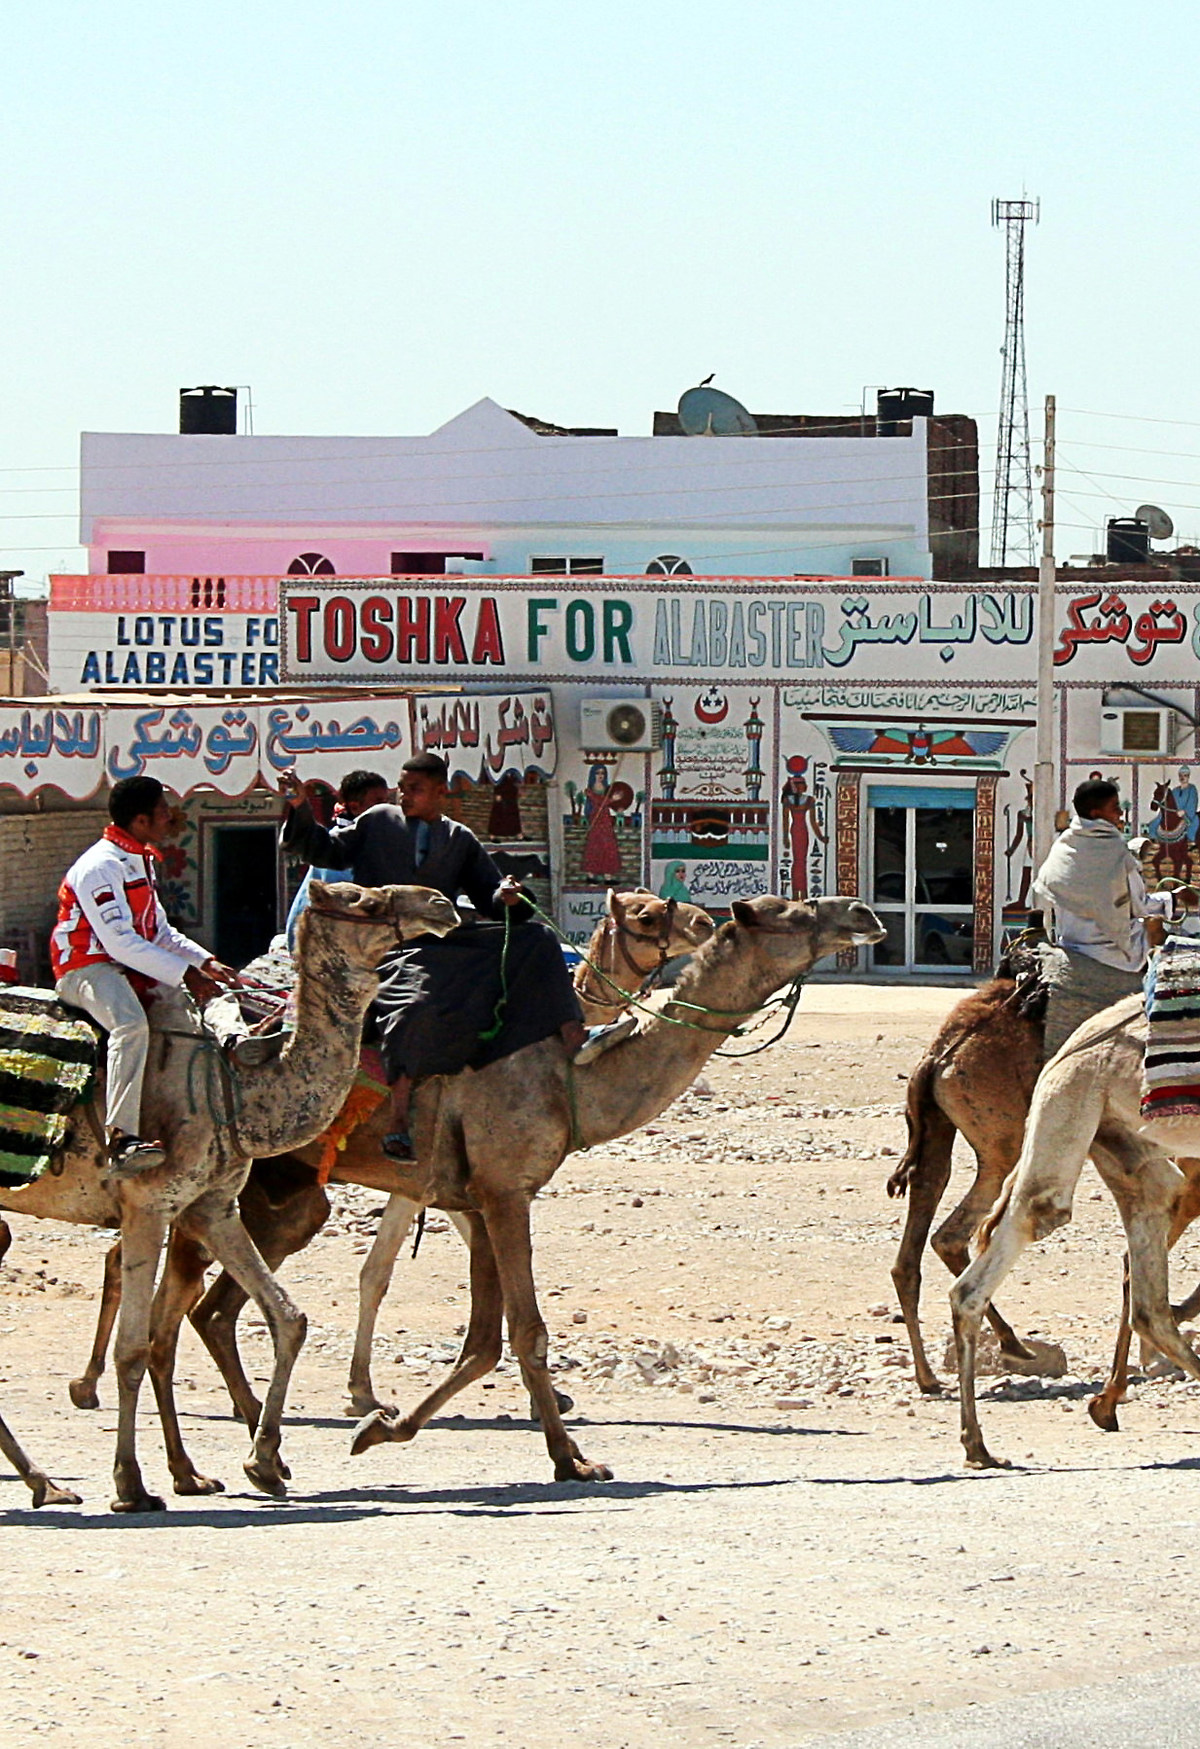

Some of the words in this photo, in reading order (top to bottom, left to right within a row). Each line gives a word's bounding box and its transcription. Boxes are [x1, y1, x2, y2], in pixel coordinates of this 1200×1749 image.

[117, 616, 223, 646] LOTUS
[247, 618, 279, 646] FO
[287, 596, 506, 666] TOSHKA
[527, 597, 634, 666] FOR
[653, 598, 826, 669] ALABASTER
[822, 592, 1035, 668] للالباستر
[80, 652, 280, 685] ALABASTER
[0, 709, 101, 779] للالباس
[107, 708, 259, 780] توشكى
[266, 704, 403, 770] مصنع
[486, 697, 553, 773] توشكى
[568, 901, 607, 916] WELC
